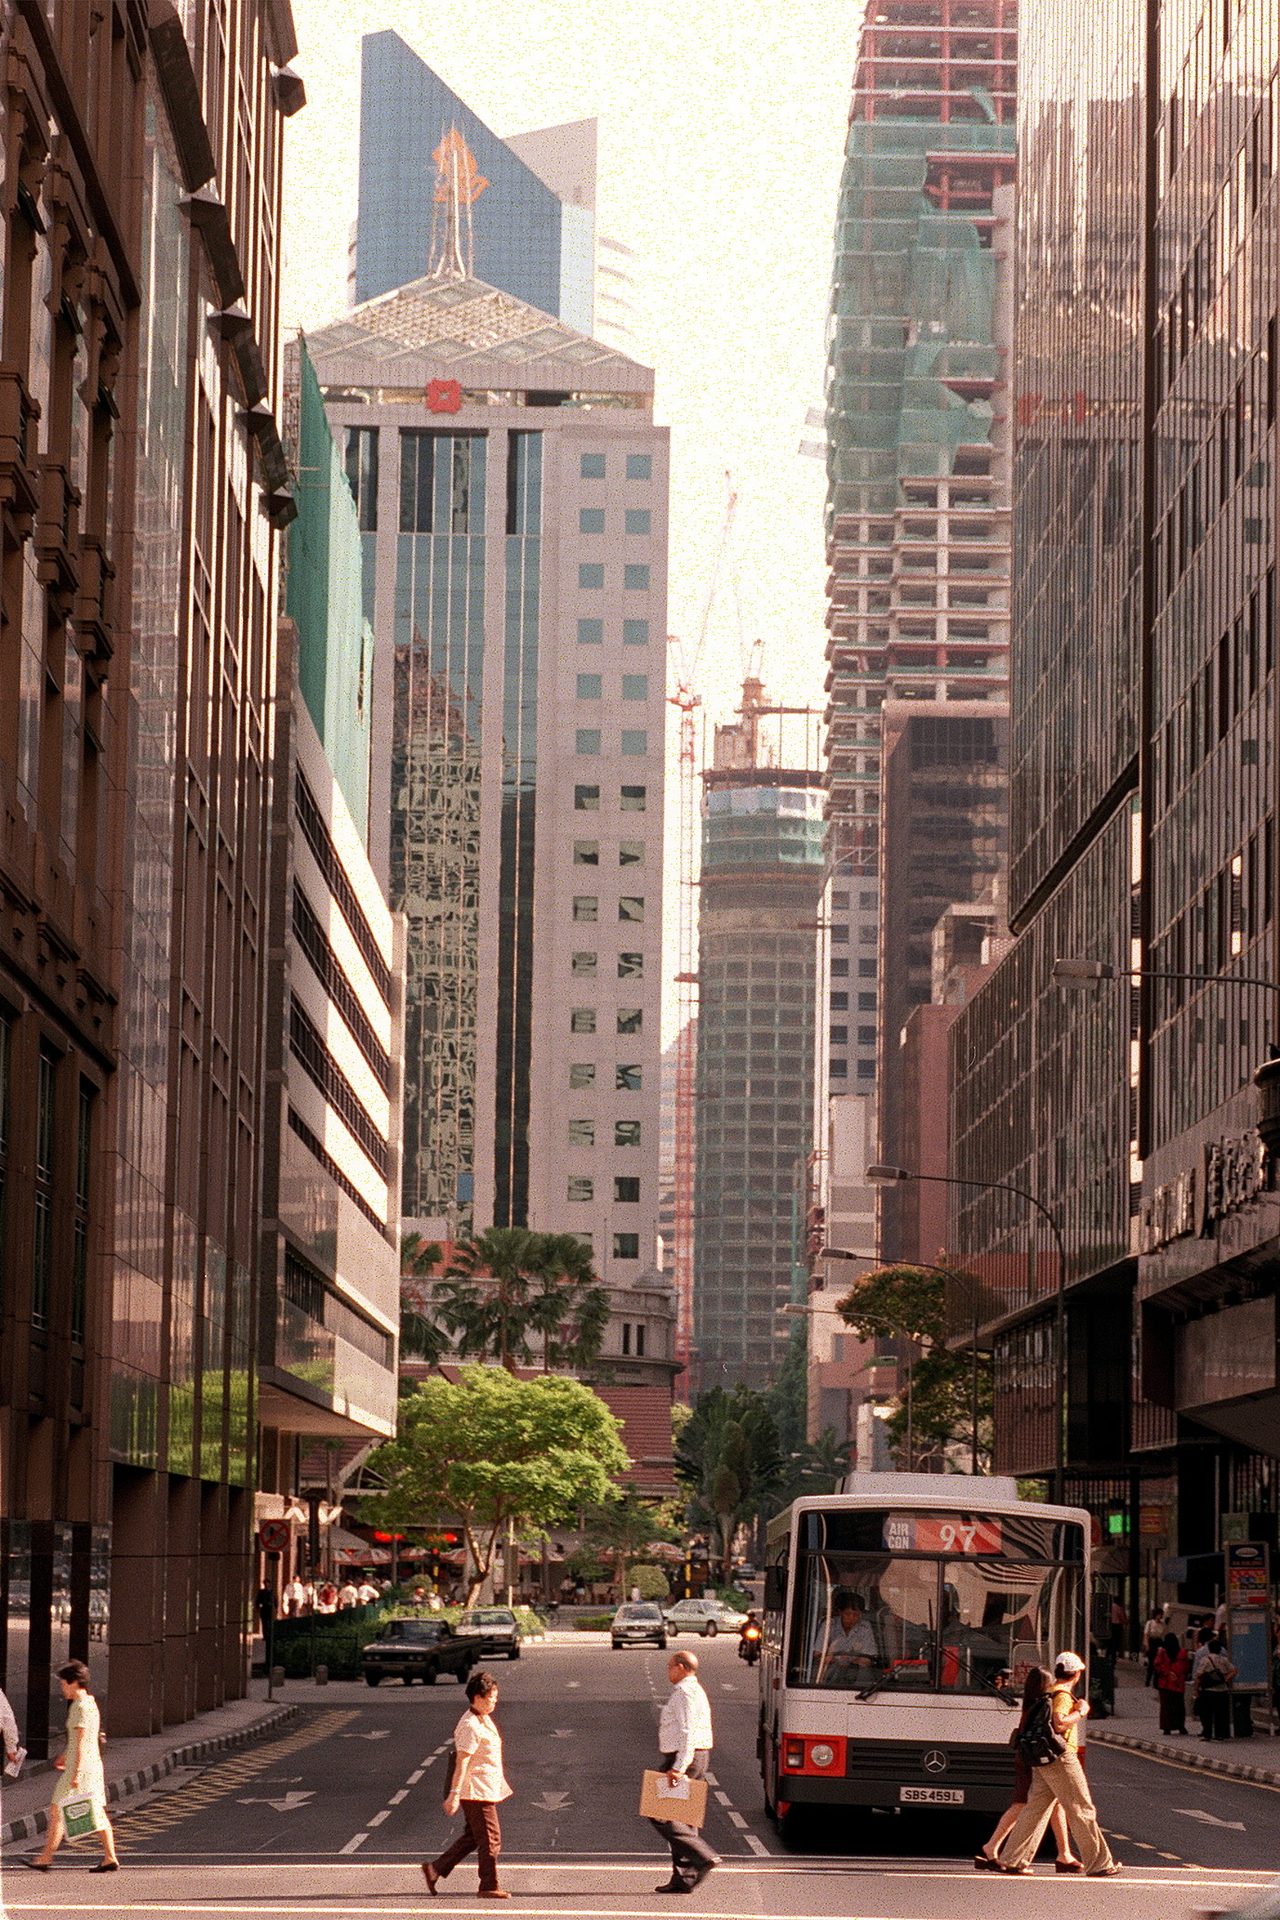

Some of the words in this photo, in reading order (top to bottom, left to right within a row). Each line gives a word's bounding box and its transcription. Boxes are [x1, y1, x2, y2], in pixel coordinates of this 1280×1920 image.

[888, 1522, 909, 1536] AIR
[887, 1536, 909, 1549] CON
[939, 1524, 976, 1552] 97
[905, 1790, 960, 1801] SBS459L
